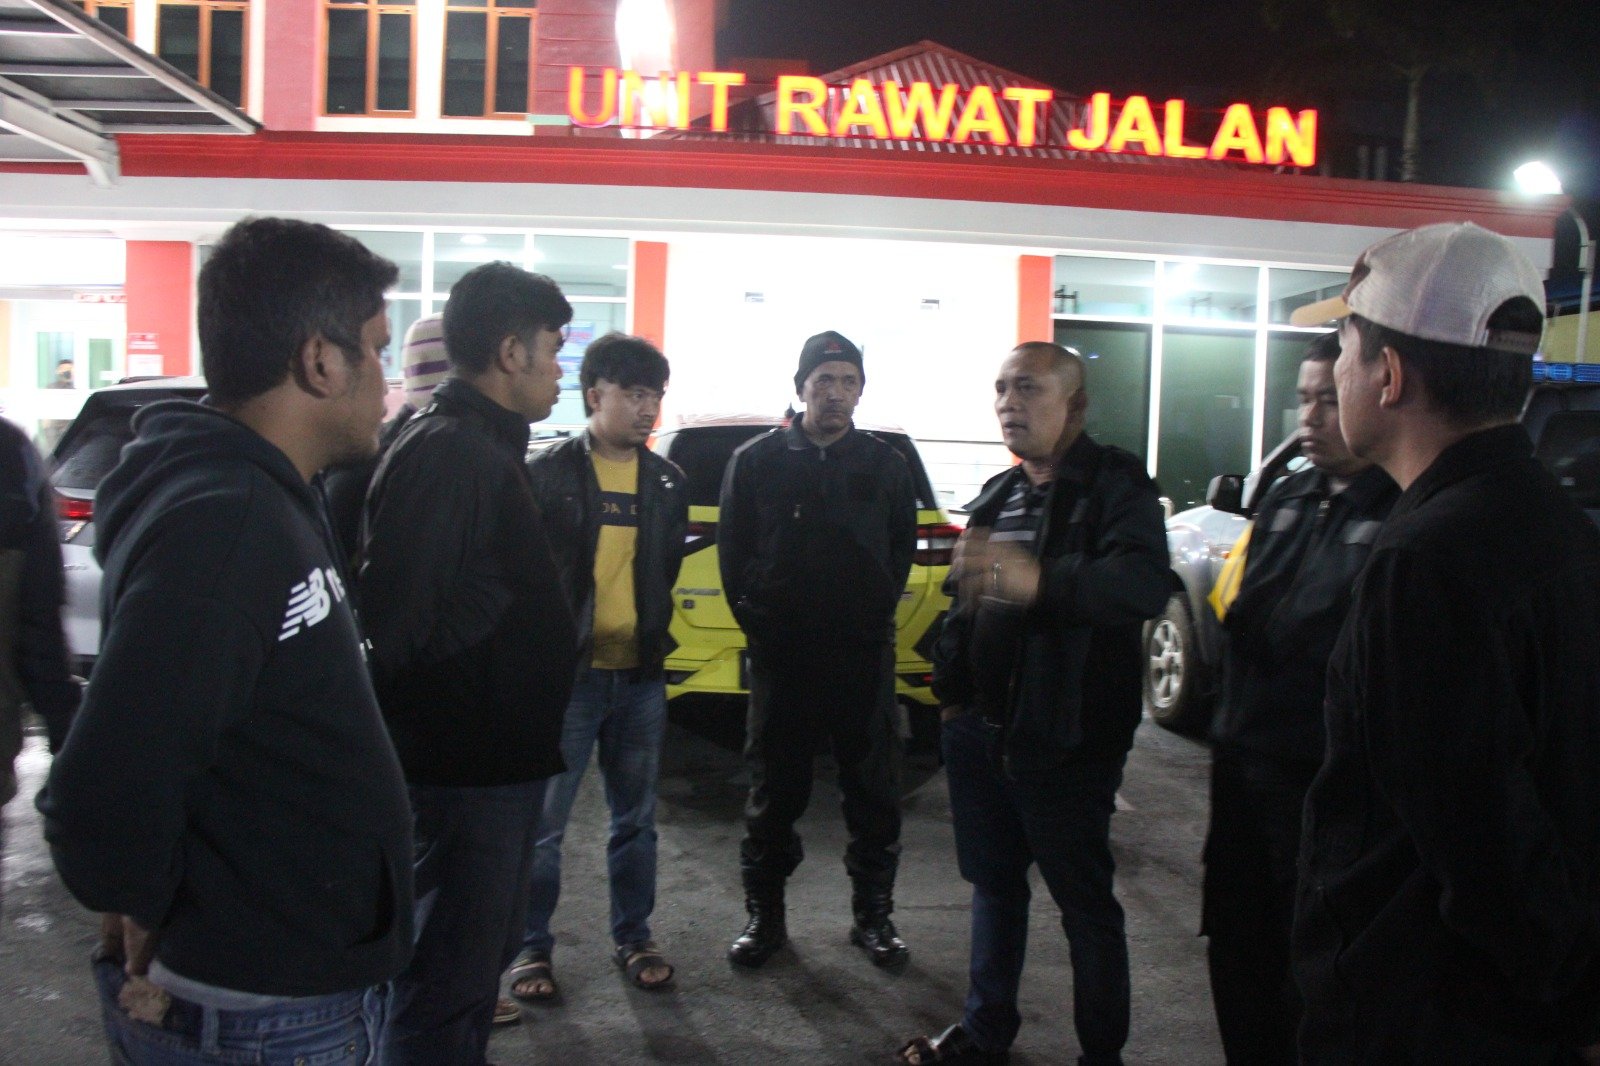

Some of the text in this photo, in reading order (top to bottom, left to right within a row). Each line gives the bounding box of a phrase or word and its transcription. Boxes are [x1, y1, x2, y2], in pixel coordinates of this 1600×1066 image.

[568, 66, 1318, 167] UNIT RAWAT JALAN
